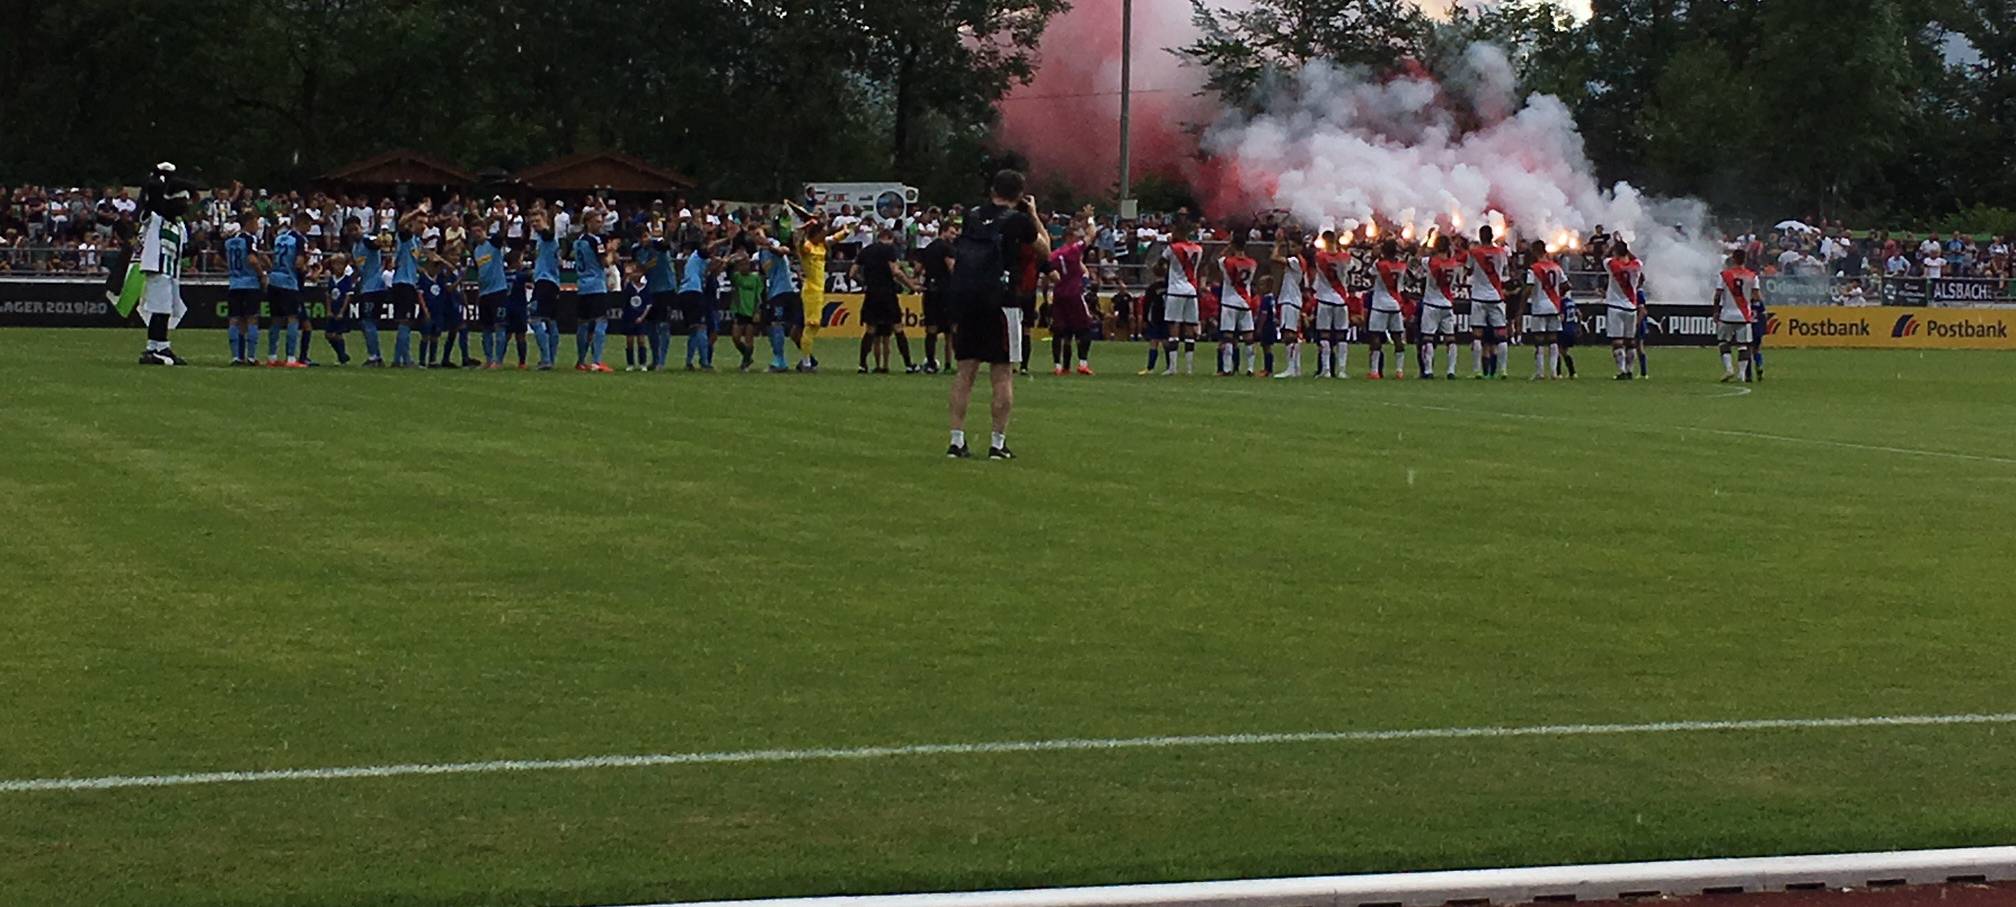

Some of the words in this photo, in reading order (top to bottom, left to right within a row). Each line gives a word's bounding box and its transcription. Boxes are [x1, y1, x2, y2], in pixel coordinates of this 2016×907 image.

[1934, 282, 1988, 300] ALSBACH
[48, 301, 108, 314] 2019/20
[1669, 316, 1717, 334] PUMA
[1789, 318, 1870, 336] Postbank
[1927, 319, 2007, 338] Postbank
